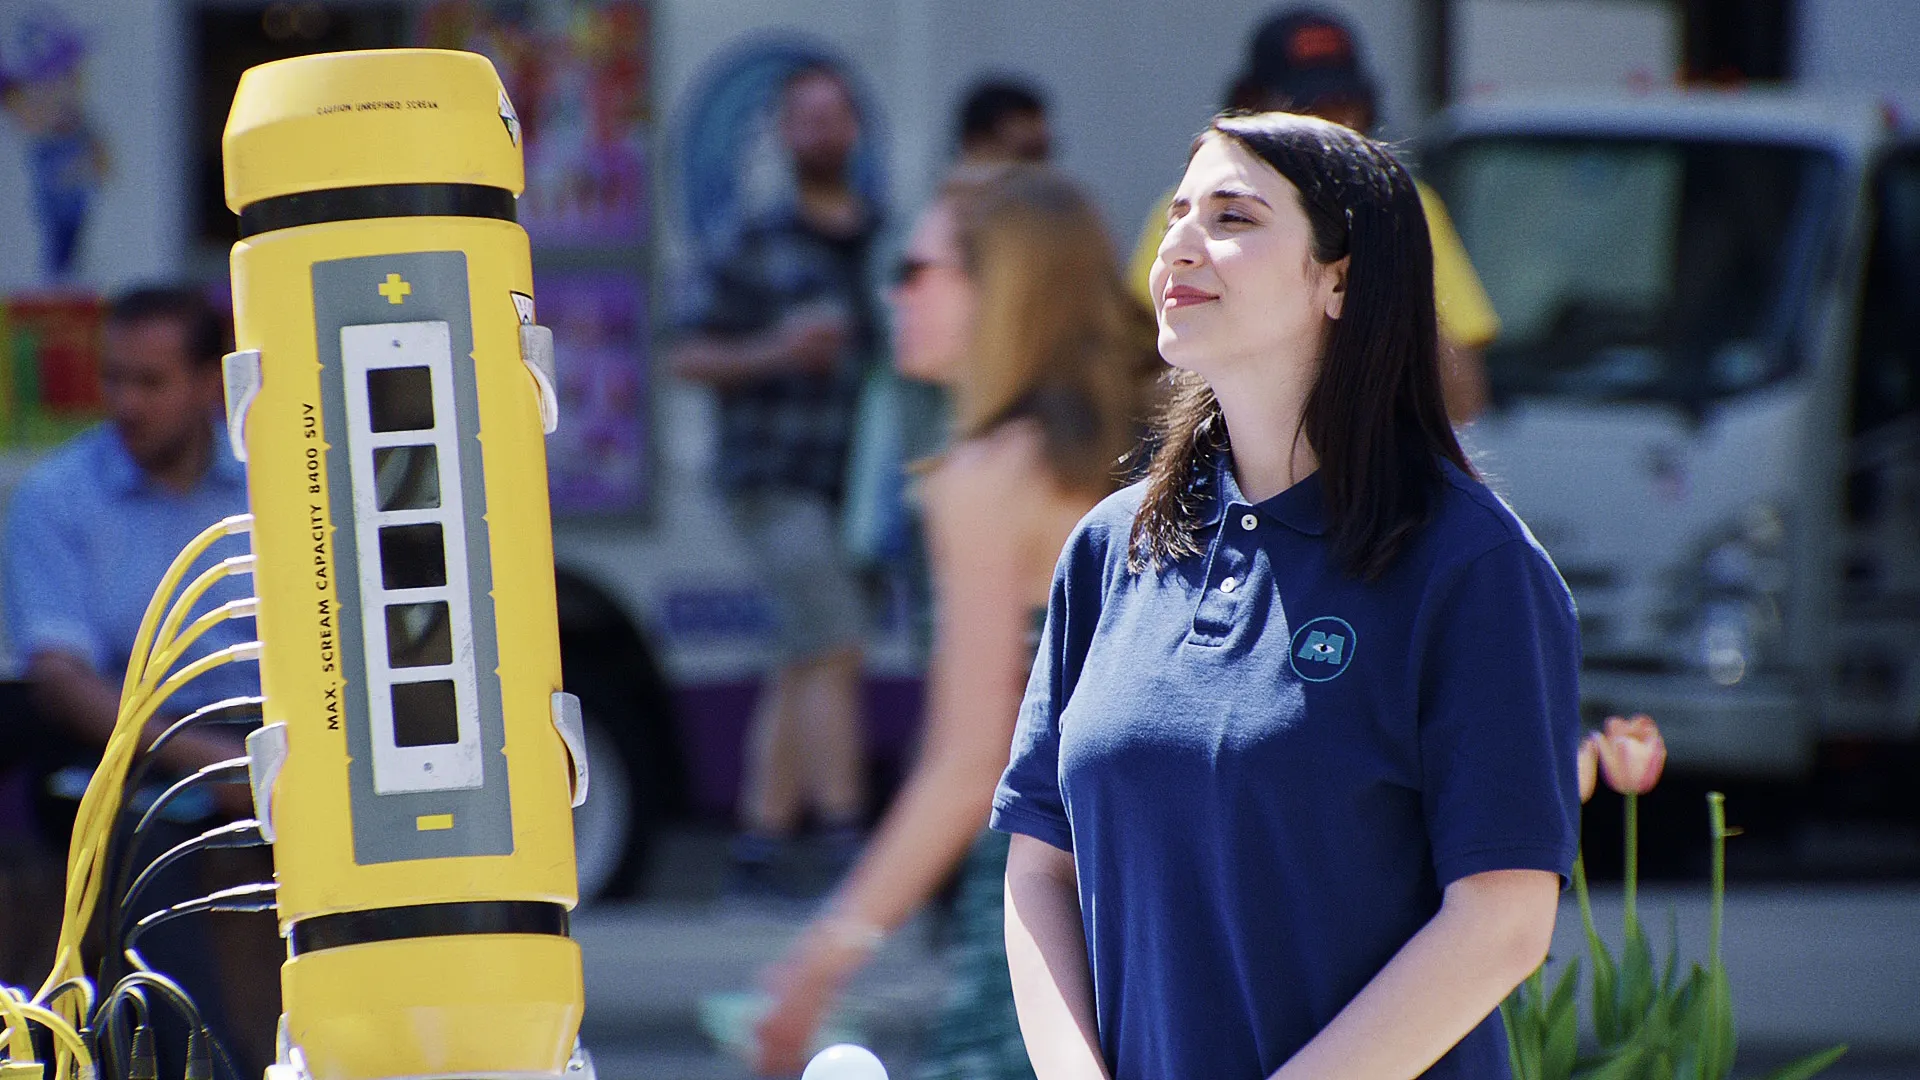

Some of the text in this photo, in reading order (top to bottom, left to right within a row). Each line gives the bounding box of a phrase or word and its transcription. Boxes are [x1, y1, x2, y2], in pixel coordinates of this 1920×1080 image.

[316, 103, 352, 116] CAUTION
[355, 100, 401, 112] UNREFINED
[302, 403, 340, 731] MAX. SCREAM CAPACITY 8400 SUV
